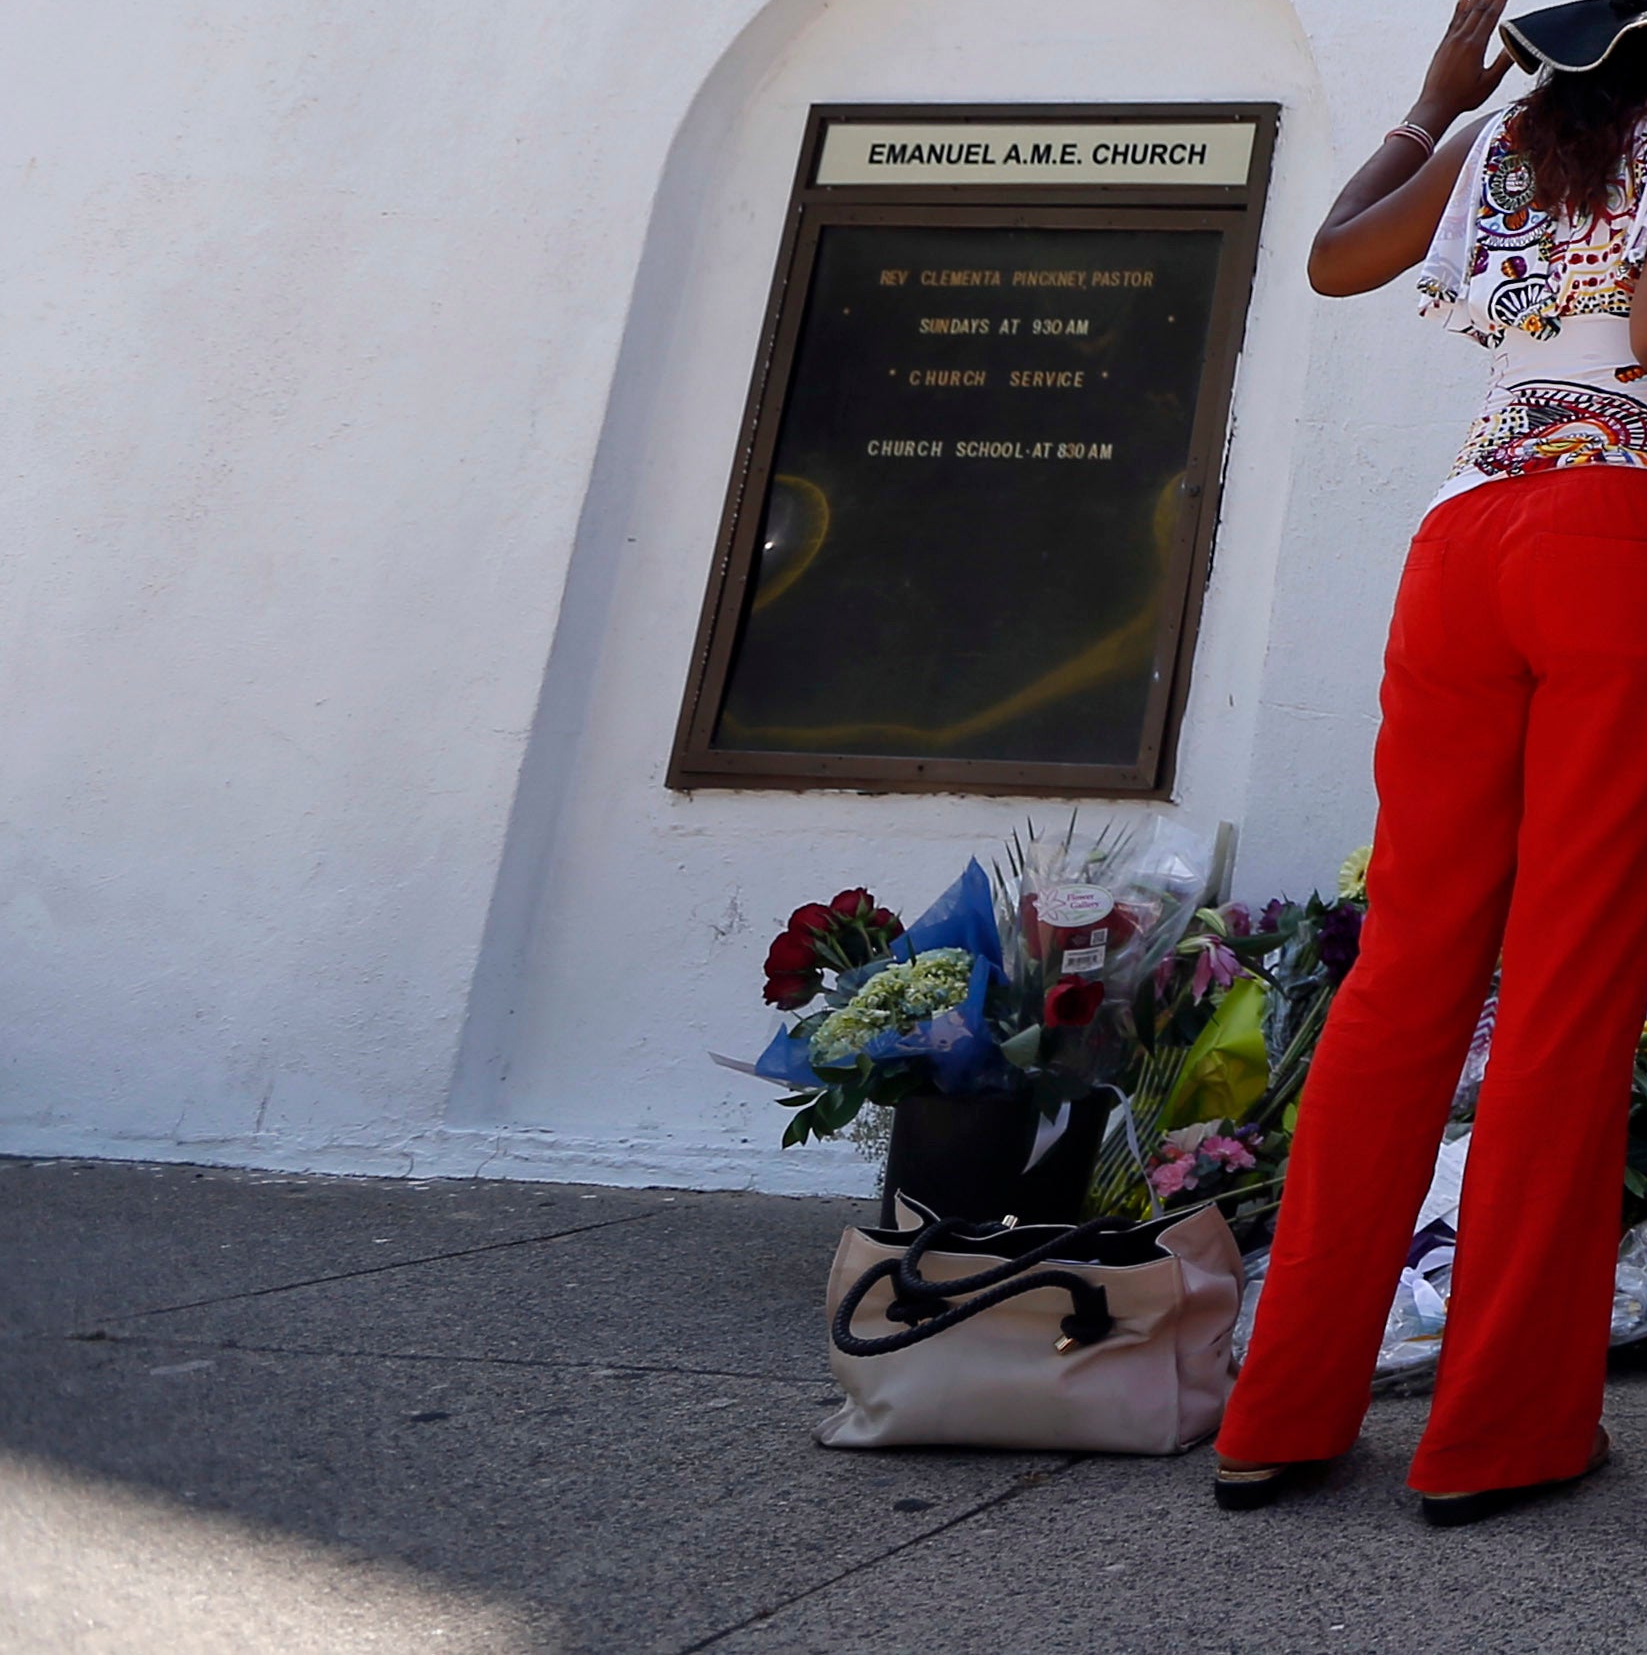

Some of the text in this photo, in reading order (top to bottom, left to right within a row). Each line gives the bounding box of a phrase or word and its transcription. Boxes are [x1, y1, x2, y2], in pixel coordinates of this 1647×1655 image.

[867, 143, 1207, 166] EMANUEL A.M.E. CHURCH
[880, 270, 909, 286] REV
[921, 270, 1001, 287] CLEMENTA
[1091, 271, 1154, 288] PASTOR
[919, 318, 990, 335] SUNDAYS
[999, 318, 1021, 335] AT
[1065, 319, 1090, 335] AM
[909, 370, 1084, 387] CHURCH SERVICE
[868, 440, 943, 457] CHURCH
[1088, 443, 1113, 460] AM
